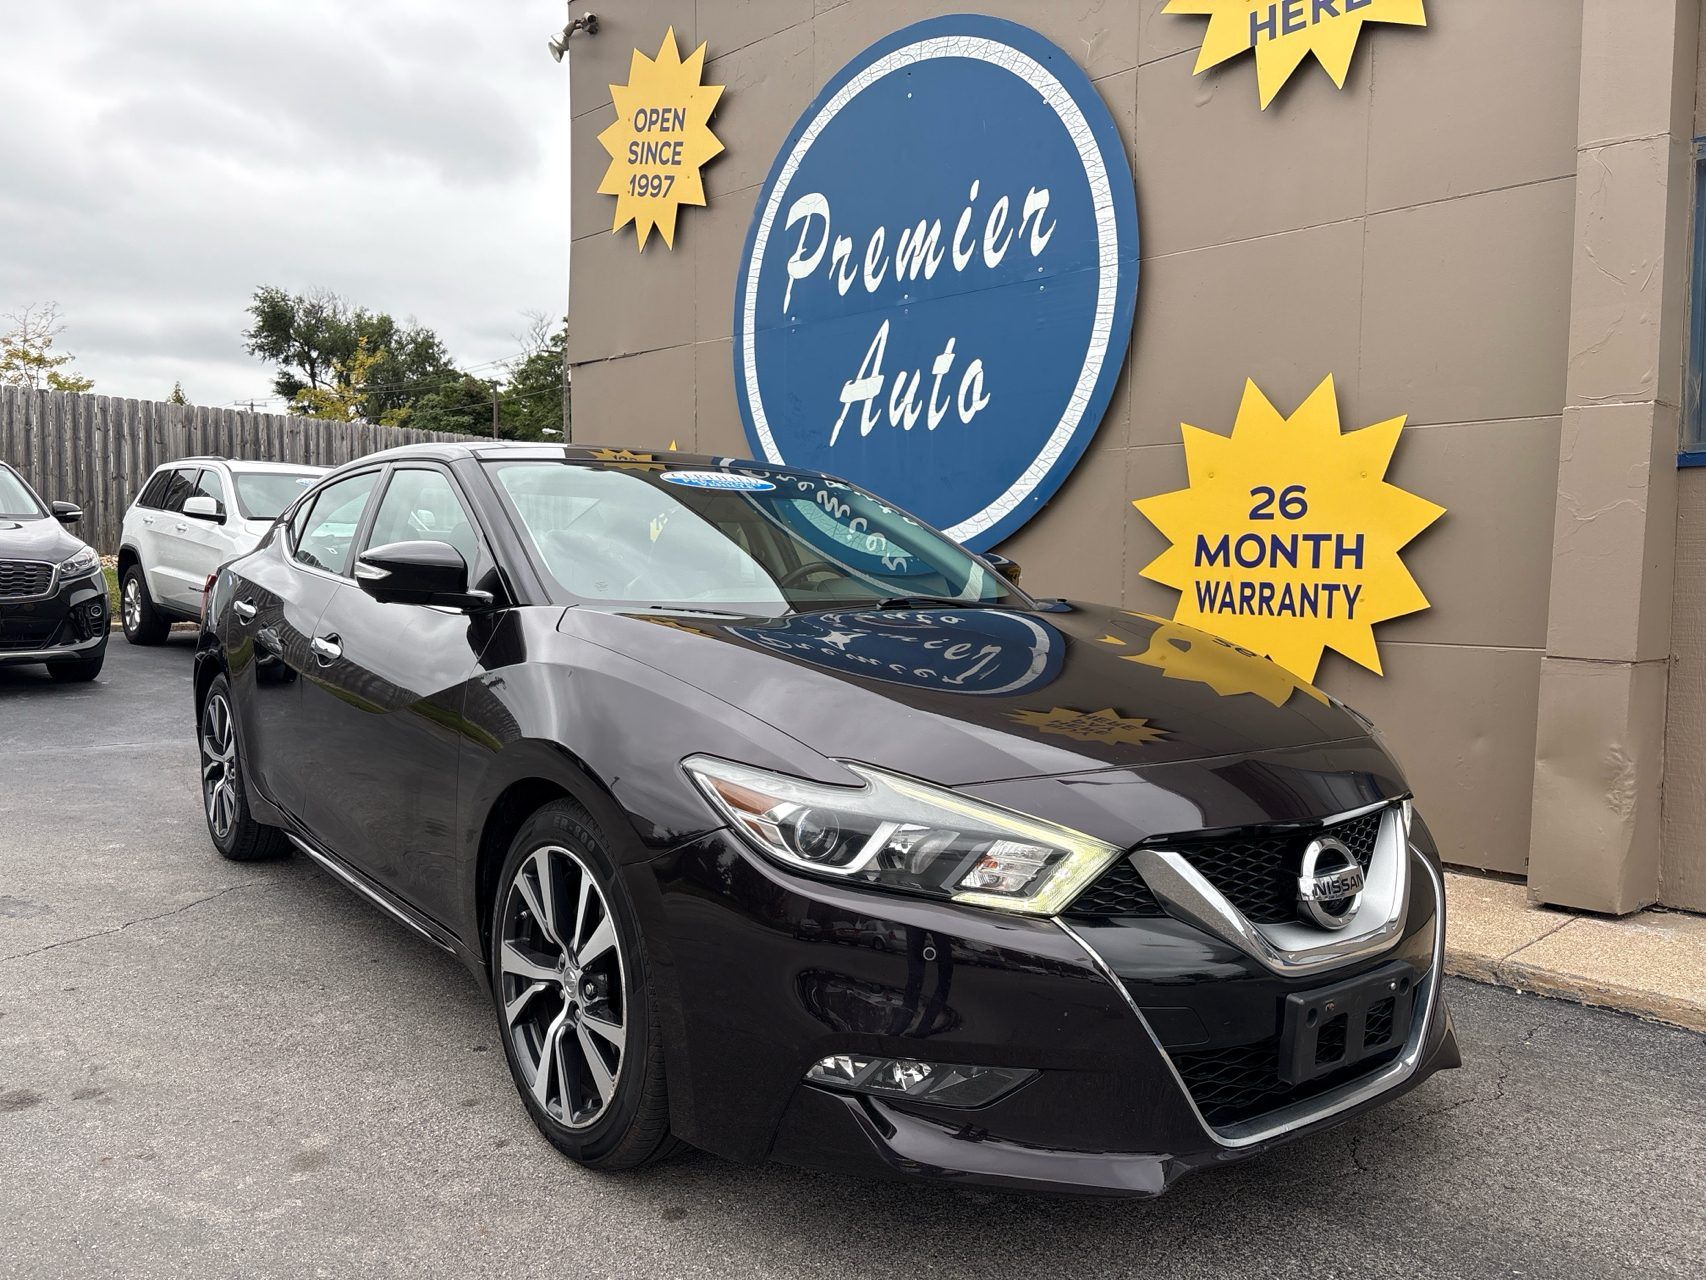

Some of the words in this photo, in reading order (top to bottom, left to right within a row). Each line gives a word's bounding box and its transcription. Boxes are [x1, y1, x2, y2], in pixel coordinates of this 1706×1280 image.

[634, 108, 687, 133] OPEN
[627, 141, 684, 165] SINCE
[629, 174, 676, 198] 1997
[783, 179, 1057, 314] Premier
[829, 319, 991, 447] Auto
[1248, 485, 1308, 520] 26
[1194, 533, 1365, 569] MONTH
[1194, 580, 1363, 620] WARRANTY
[1312, 873, 1364, 898] NISSAN
